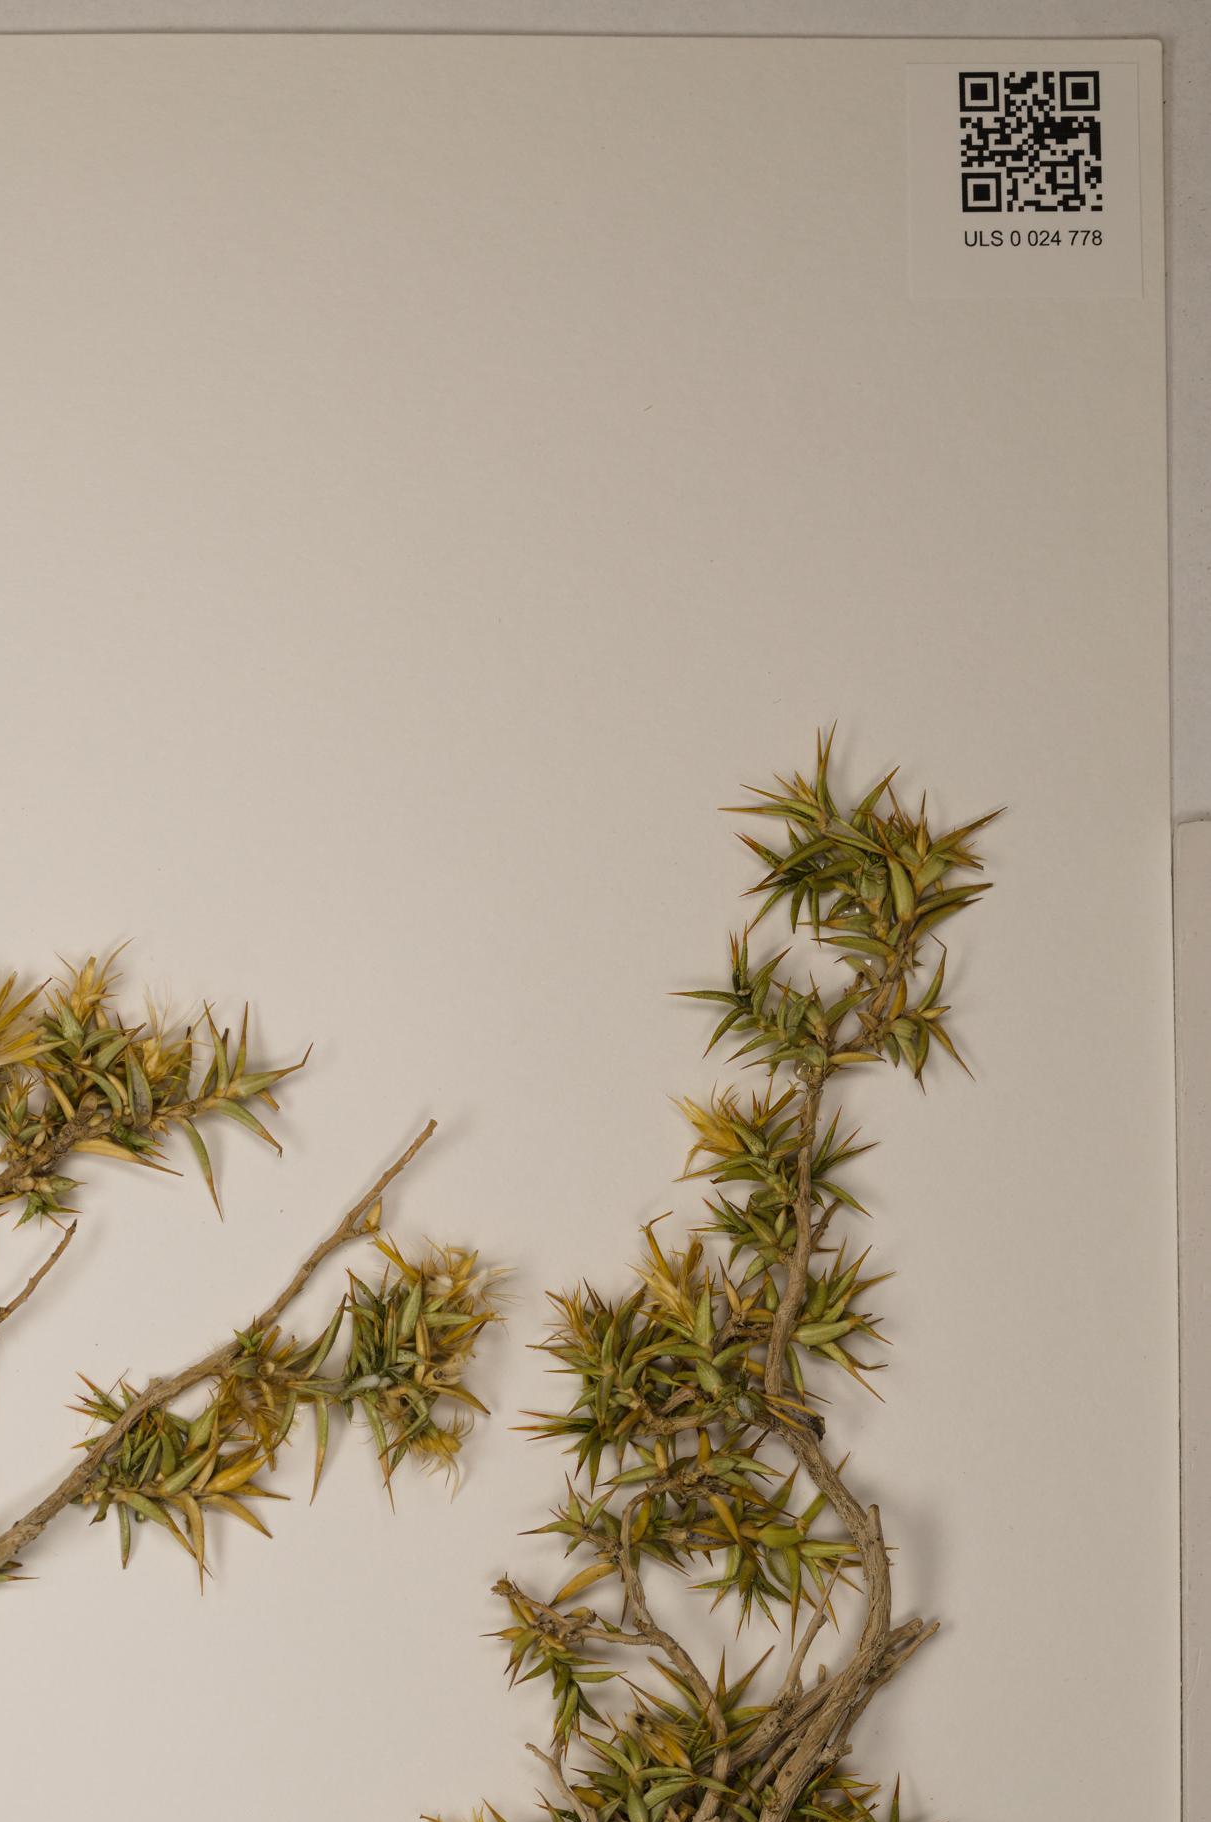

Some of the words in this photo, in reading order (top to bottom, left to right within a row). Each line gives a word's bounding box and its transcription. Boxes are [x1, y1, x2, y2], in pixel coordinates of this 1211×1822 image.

[964, 229, 1004, 248] ULS
[1010, 230, 1022, 247] 0
[1027, 229, 1062, 247] 024
[1068, 229, 1103, 246] 778
